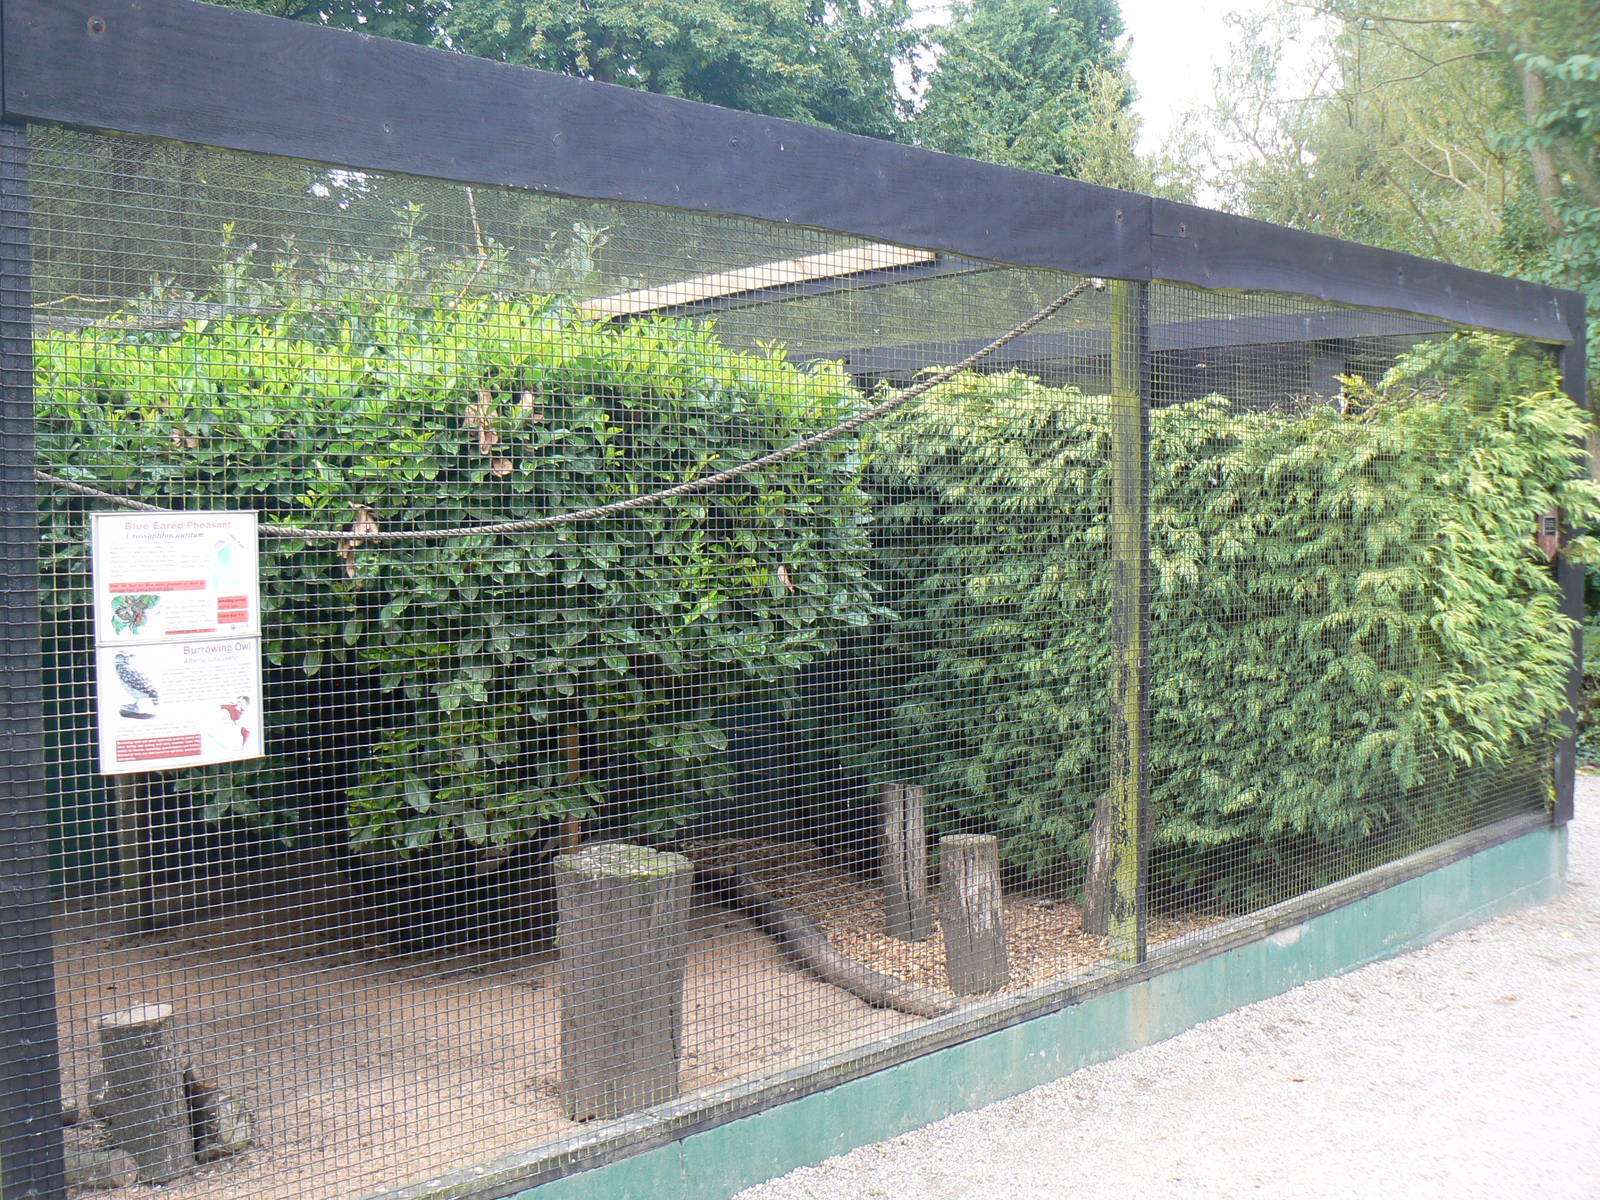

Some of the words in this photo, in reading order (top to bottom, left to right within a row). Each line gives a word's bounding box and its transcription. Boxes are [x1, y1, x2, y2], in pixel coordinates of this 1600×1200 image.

[124, 522, 149, 530] Blue
[153, 521, 183, 530] Eared
[186, 520, 231, 529] Pheasant
[183, 644, 232, 655] Burrowing
[235, 641, 251, 651] Owl
